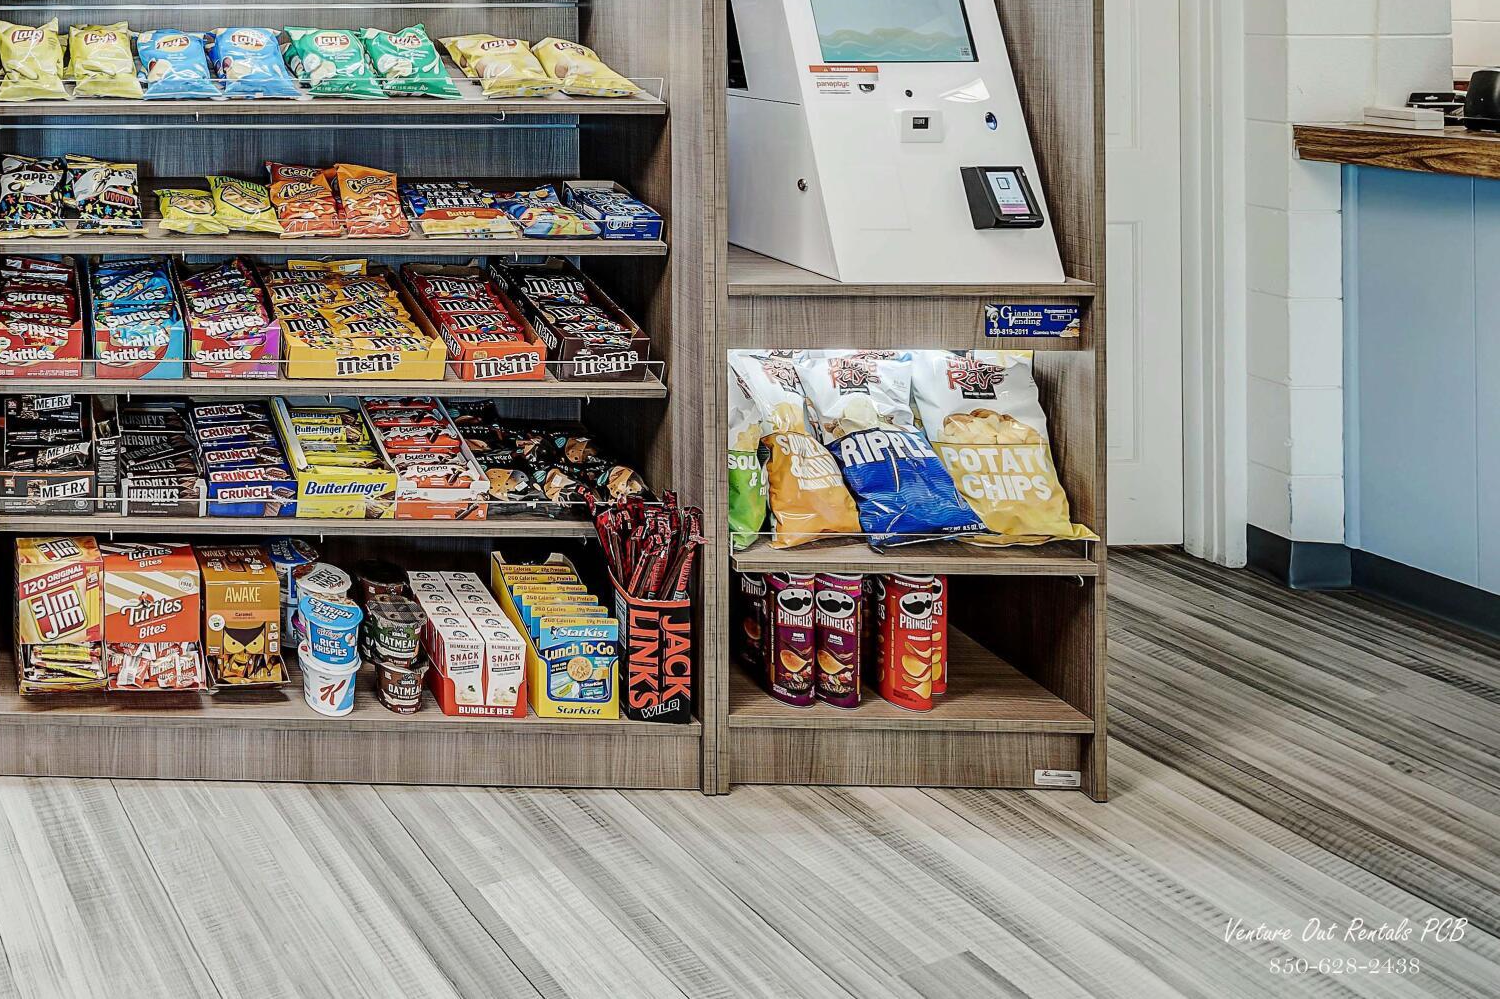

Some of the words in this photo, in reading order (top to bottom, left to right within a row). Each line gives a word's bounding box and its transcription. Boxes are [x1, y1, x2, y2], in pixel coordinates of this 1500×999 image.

[104, 191, 134, 206] VOODOO
[446, 209, 475, 218] Butter
[1000, 305, 1043, 319] Giambra
[1008, 316, 1041, 327] Vending
[988, 328, 1029, 336] 850-819-2011
[100, 348, 156, 364] Skittles
[196, 348, 252, 364] Skittles
[196, 405, 243, 418] CRUNCH
[294, 424, 343, 436] Butterfinger
[121, 434, 168, 446] HERSHEY'S
[840, 430, 933, 467] RIPPLE
[416, 464, 449, 474] bueno
[129, 488, 180, 500] HERSHEY'S
[219, 486, 270, 499] CRUNCH
[304, 481, 387, 496] Butterfinger
[962, 474, 1052, 501] CHIPS
[139, 558, 162, 568] Bites
[22, 579, 48, 595] 120
[47, 565, 84, 582] ORIGINAL
[224, 586, 261, 603] AWAKE
[121, 598, 183, 626] Turtles
[777, 609, 813, 628] PRINGLES
[815, 609, 855, 633] PRINGLES
[138, 622, 167, 639] Bites
[559, 625, 610, 638] StarKist
[319, 637, 341, 649] RICE
[379, 633, 417, 649] OATMEAL
[313, 643, 348, 657] KRISPIES
[450, 652, 479, 662] SNACK
[491, 652, 520, 662] SNACK
[544, 643, 580, 661] Lunch
[581, 640, 615, 656] To-Go
[628, 607, 660, 709] LINK'S
[660, 615, 691, 706] JACK
[388, 682, 422, 695] OATMEAL
[458, 705, 495, 715] BUMBLE
[496, 705, 515, 716] BEE
[556, 705, 602, 715] StarKist
[641, 698, 681, 719] WILD
